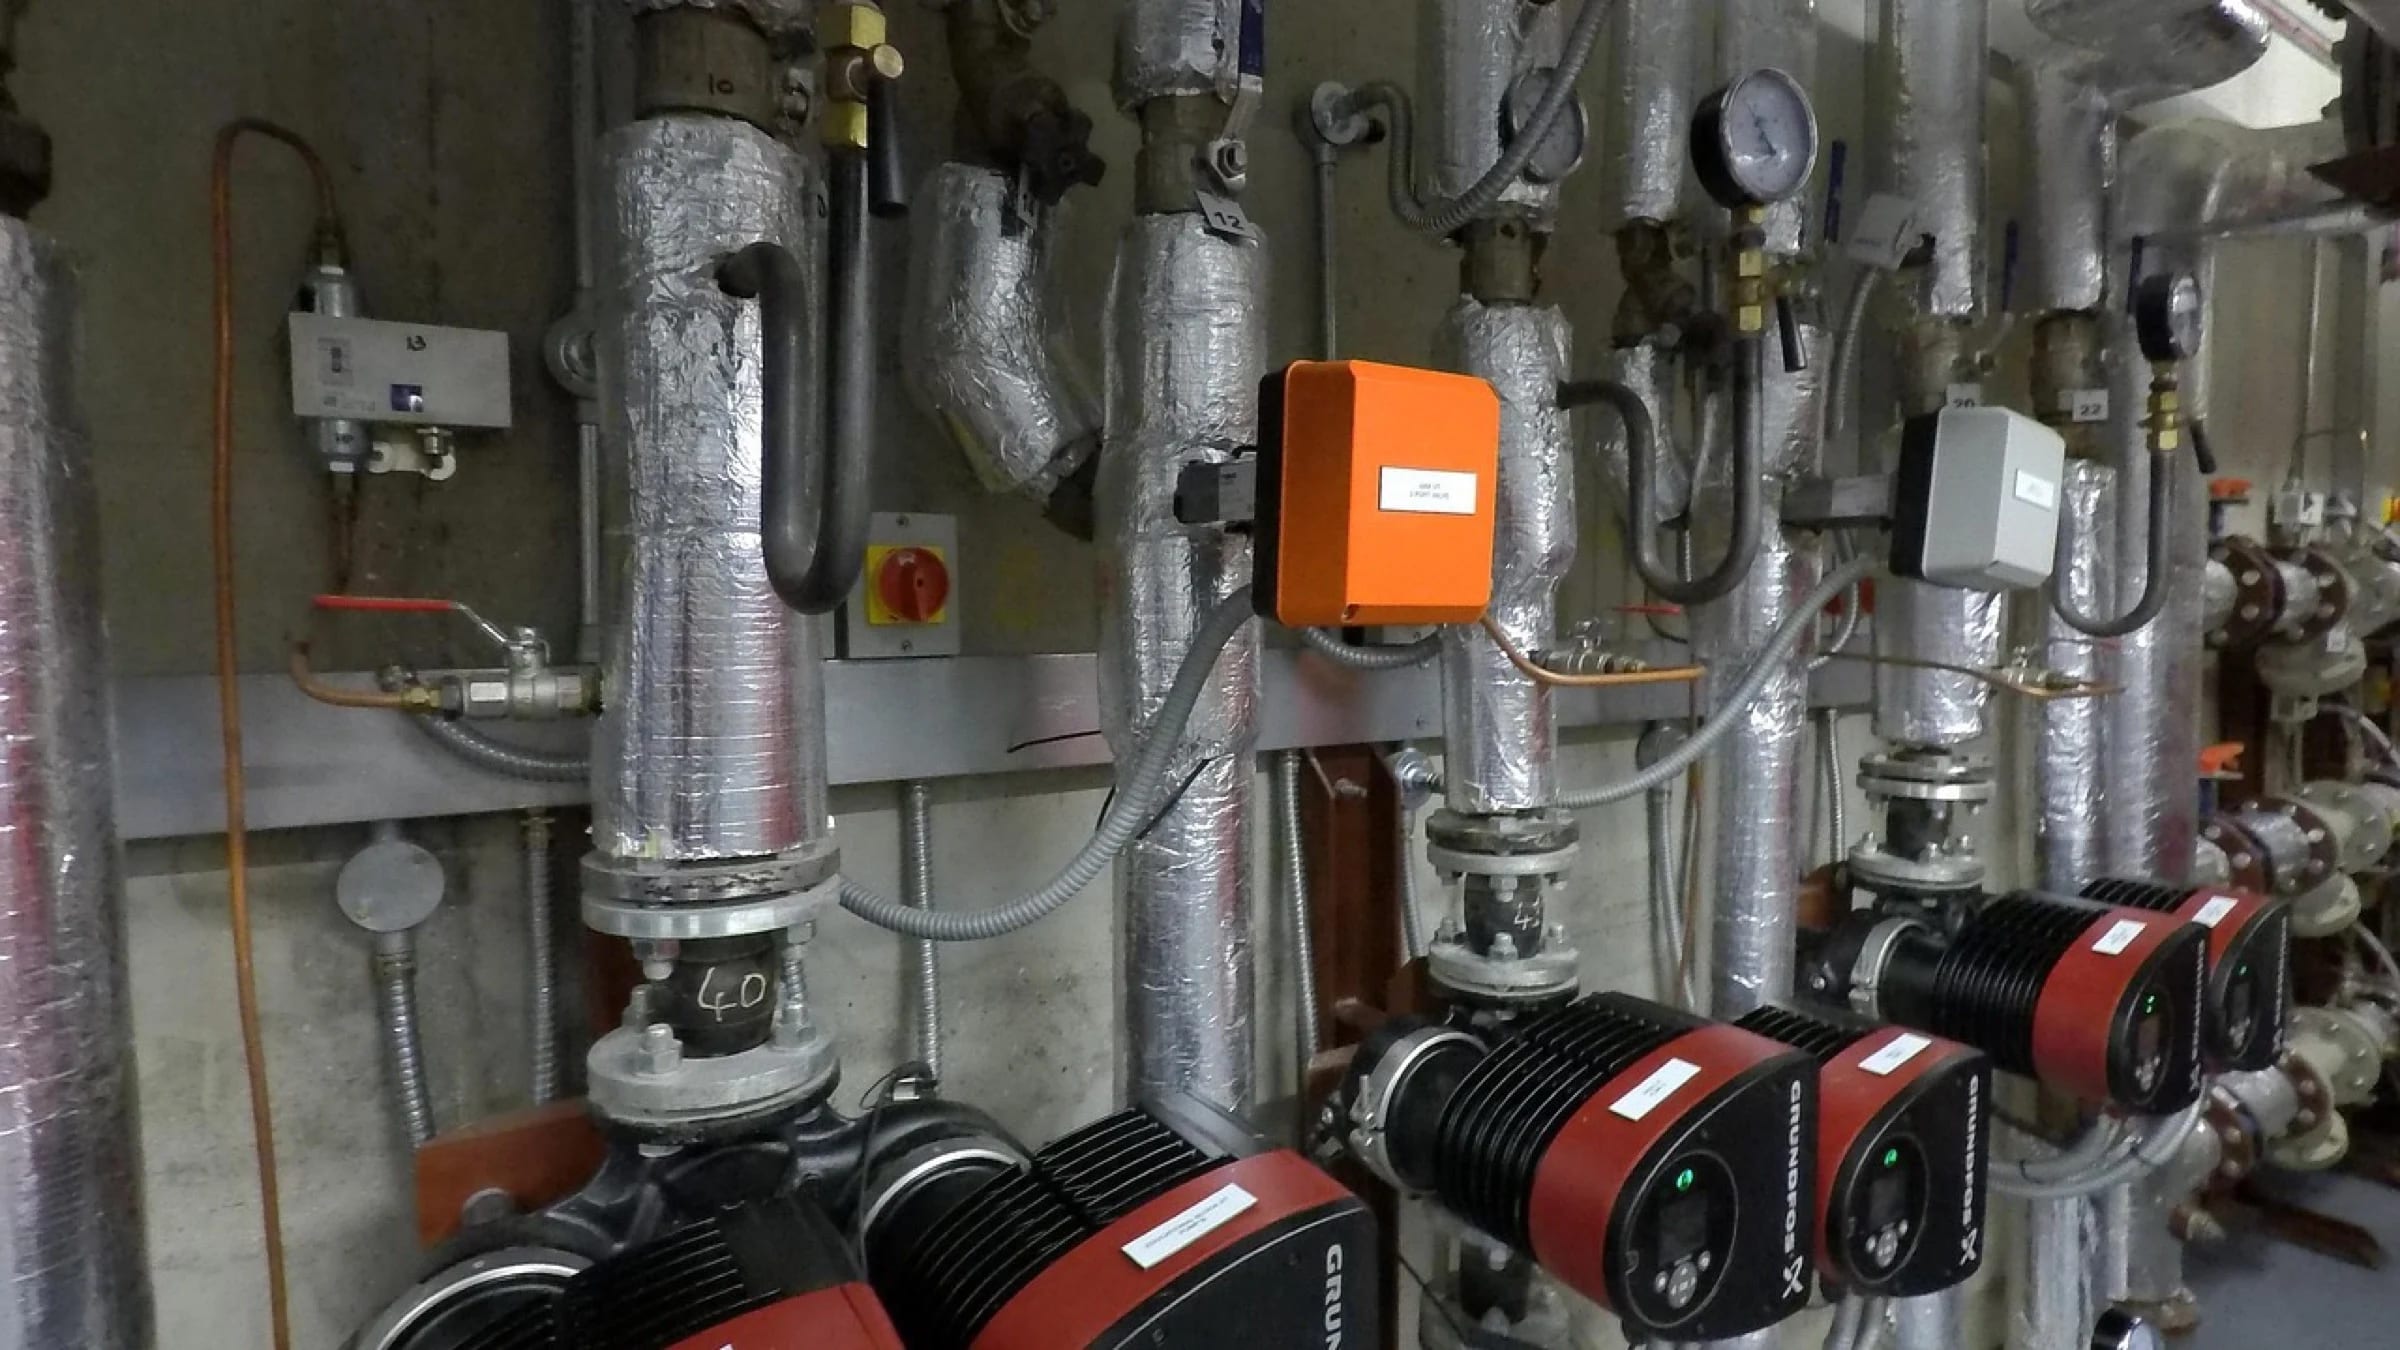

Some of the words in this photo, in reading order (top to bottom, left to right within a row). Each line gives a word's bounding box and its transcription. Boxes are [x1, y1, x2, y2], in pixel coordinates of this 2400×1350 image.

[1214, 211, 1245, 231] 12
[2079, 404, 2103, 417] 22
[697, 966, 766, 1023] 40
[1784, 1079, 1801, 1254] GRUNDFOS
